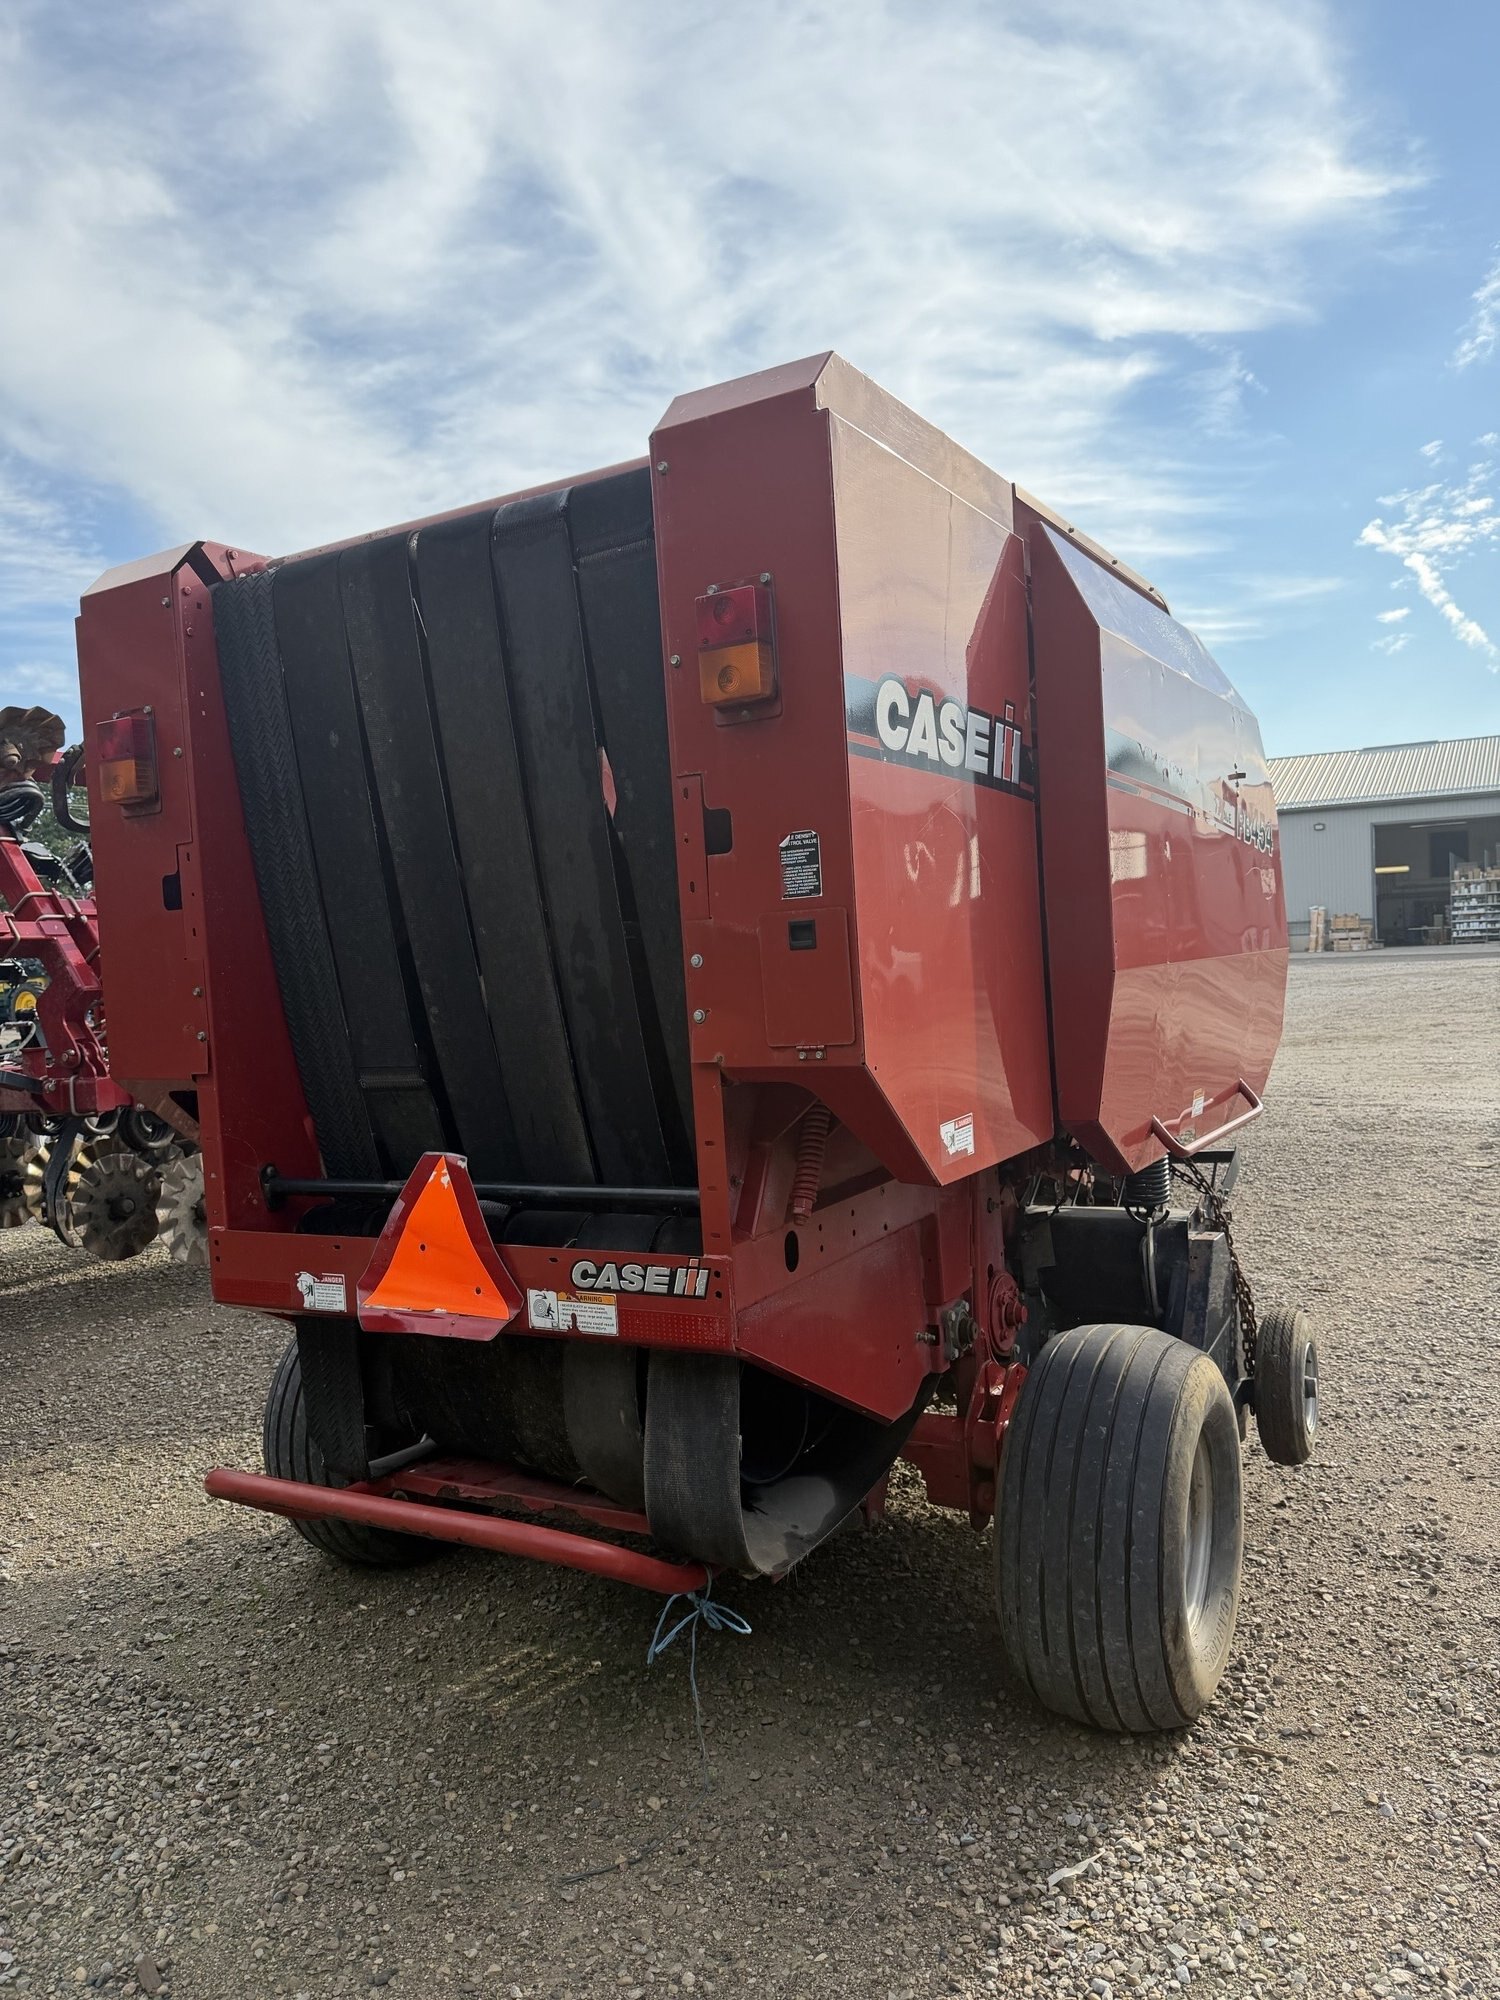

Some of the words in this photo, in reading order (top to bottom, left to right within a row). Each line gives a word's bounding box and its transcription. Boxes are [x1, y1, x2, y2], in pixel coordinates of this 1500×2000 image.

[876, 679, 990, 775] CASE
[572, 1261, 670, 1294] CASE
[578, 1295, 603, 1303] ARNING
